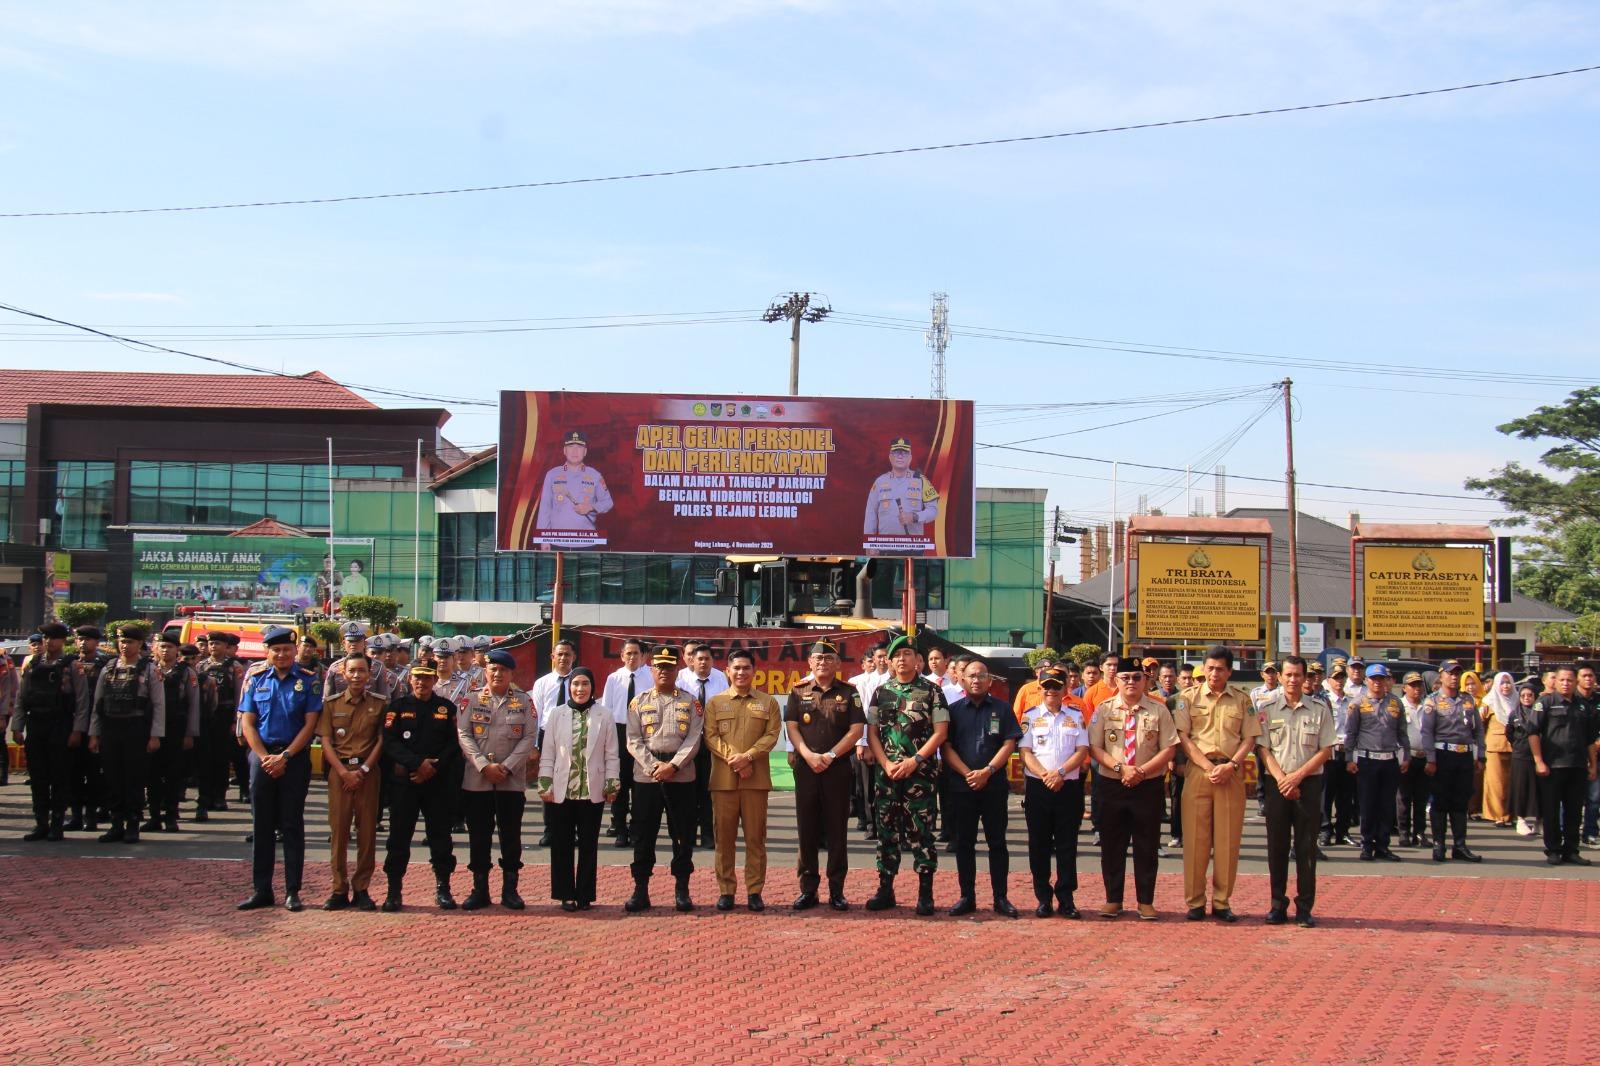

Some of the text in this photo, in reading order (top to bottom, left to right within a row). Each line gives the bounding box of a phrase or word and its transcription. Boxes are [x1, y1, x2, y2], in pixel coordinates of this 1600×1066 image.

[636, 425, 834, 452] APEL GELAR PERSONEL
[644, 450, 827, 475] DAN PERLENGKAPAN
[644, 475, 825, 489] DALAM RANGKA TANGGAP DARURAT
[659, 489, 813, 504] BENCANA HIDROMETEOROLOGI
[674, 504, 798, 518] POLRES REJANG LEBONG
[694, 541, 711, 549] Rejang
[712, 541, 731, 549] Lebong,
[140, 551, 262, 564] JAKSA SAHABAT ANAK
[160, 563, 190, 571] GENERASI
[1166, 569, 1232, 578] TRI BRATA
[1370, 571, 1478, 581] CATUR PRASETYA
[778, 640, 856, 663] APL
